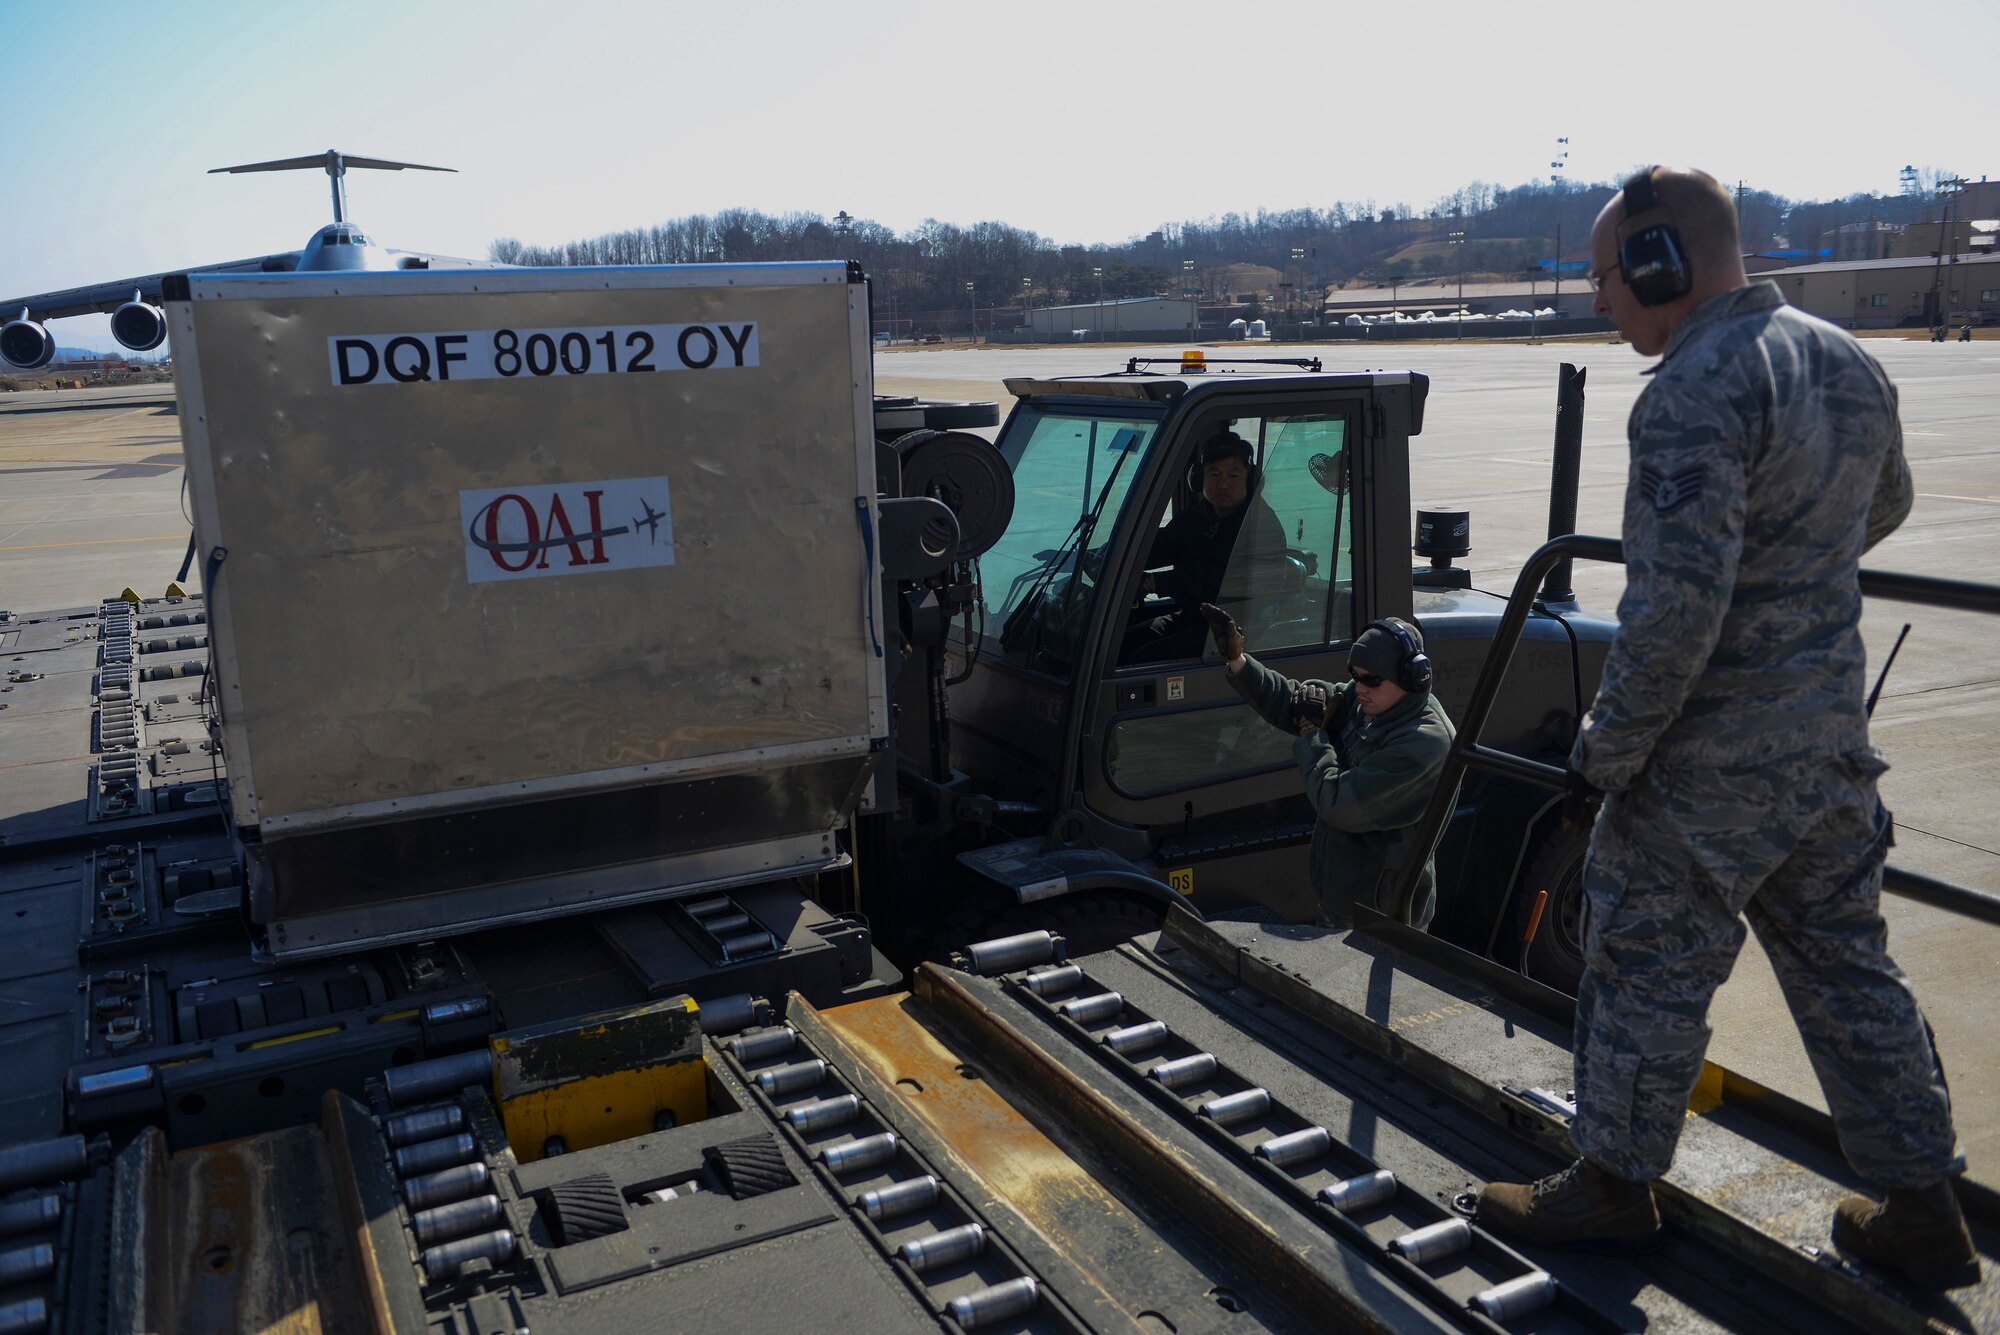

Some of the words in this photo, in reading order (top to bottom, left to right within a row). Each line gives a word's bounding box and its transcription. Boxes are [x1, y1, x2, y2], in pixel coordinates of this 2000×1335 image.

[336, 335, 468, 385] DQF
[493, 329, 656, 376] 80012
[677, 325, 754, 369] OY
[485, 490, 610, 572] OAI
[1172, 874, 1190, 891] DS
